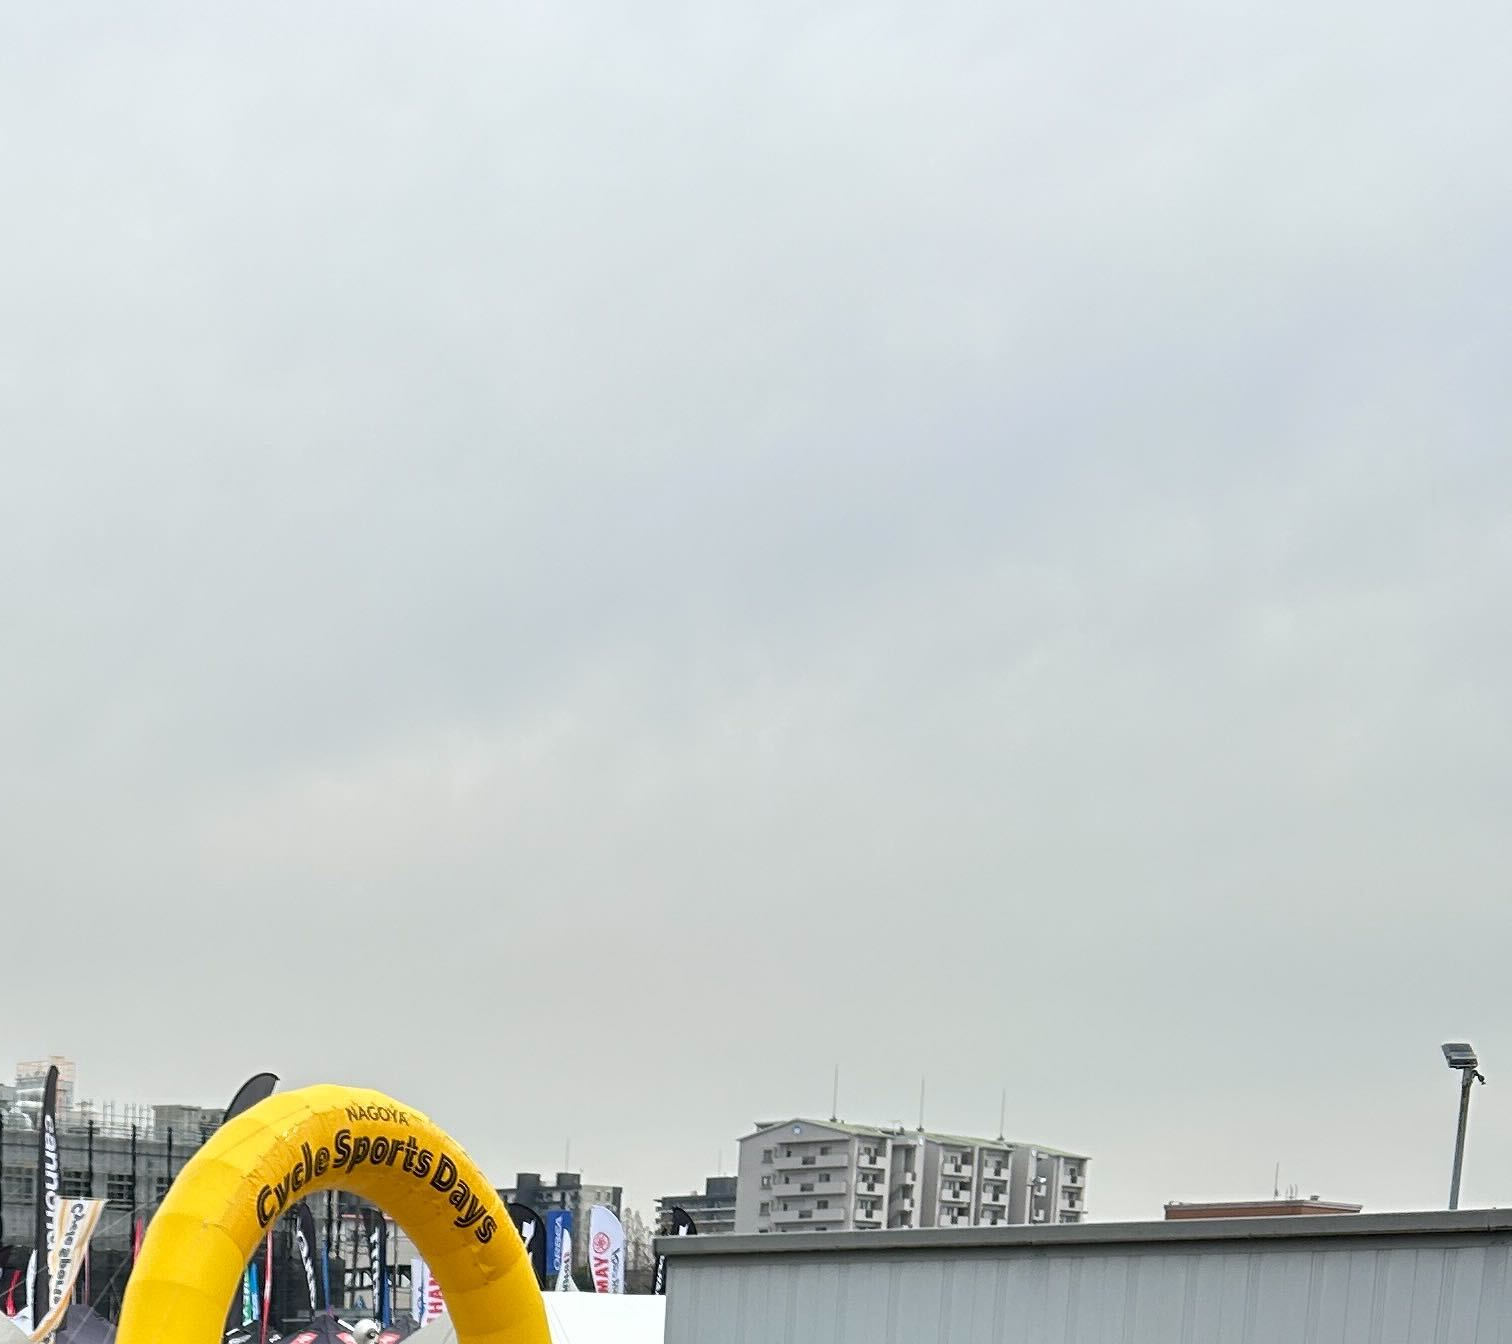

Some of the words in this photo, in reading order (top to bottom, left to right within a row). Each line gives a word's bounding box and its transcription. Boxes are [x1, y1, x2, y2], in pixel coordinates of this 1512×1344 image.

[346, 1105, 410, 1126] NAGOYA
[256, 1142, 330, 1228] Cycle
[332, 1129, 433, 1178] Sports
[430, 1152, 498, 1244] Days
